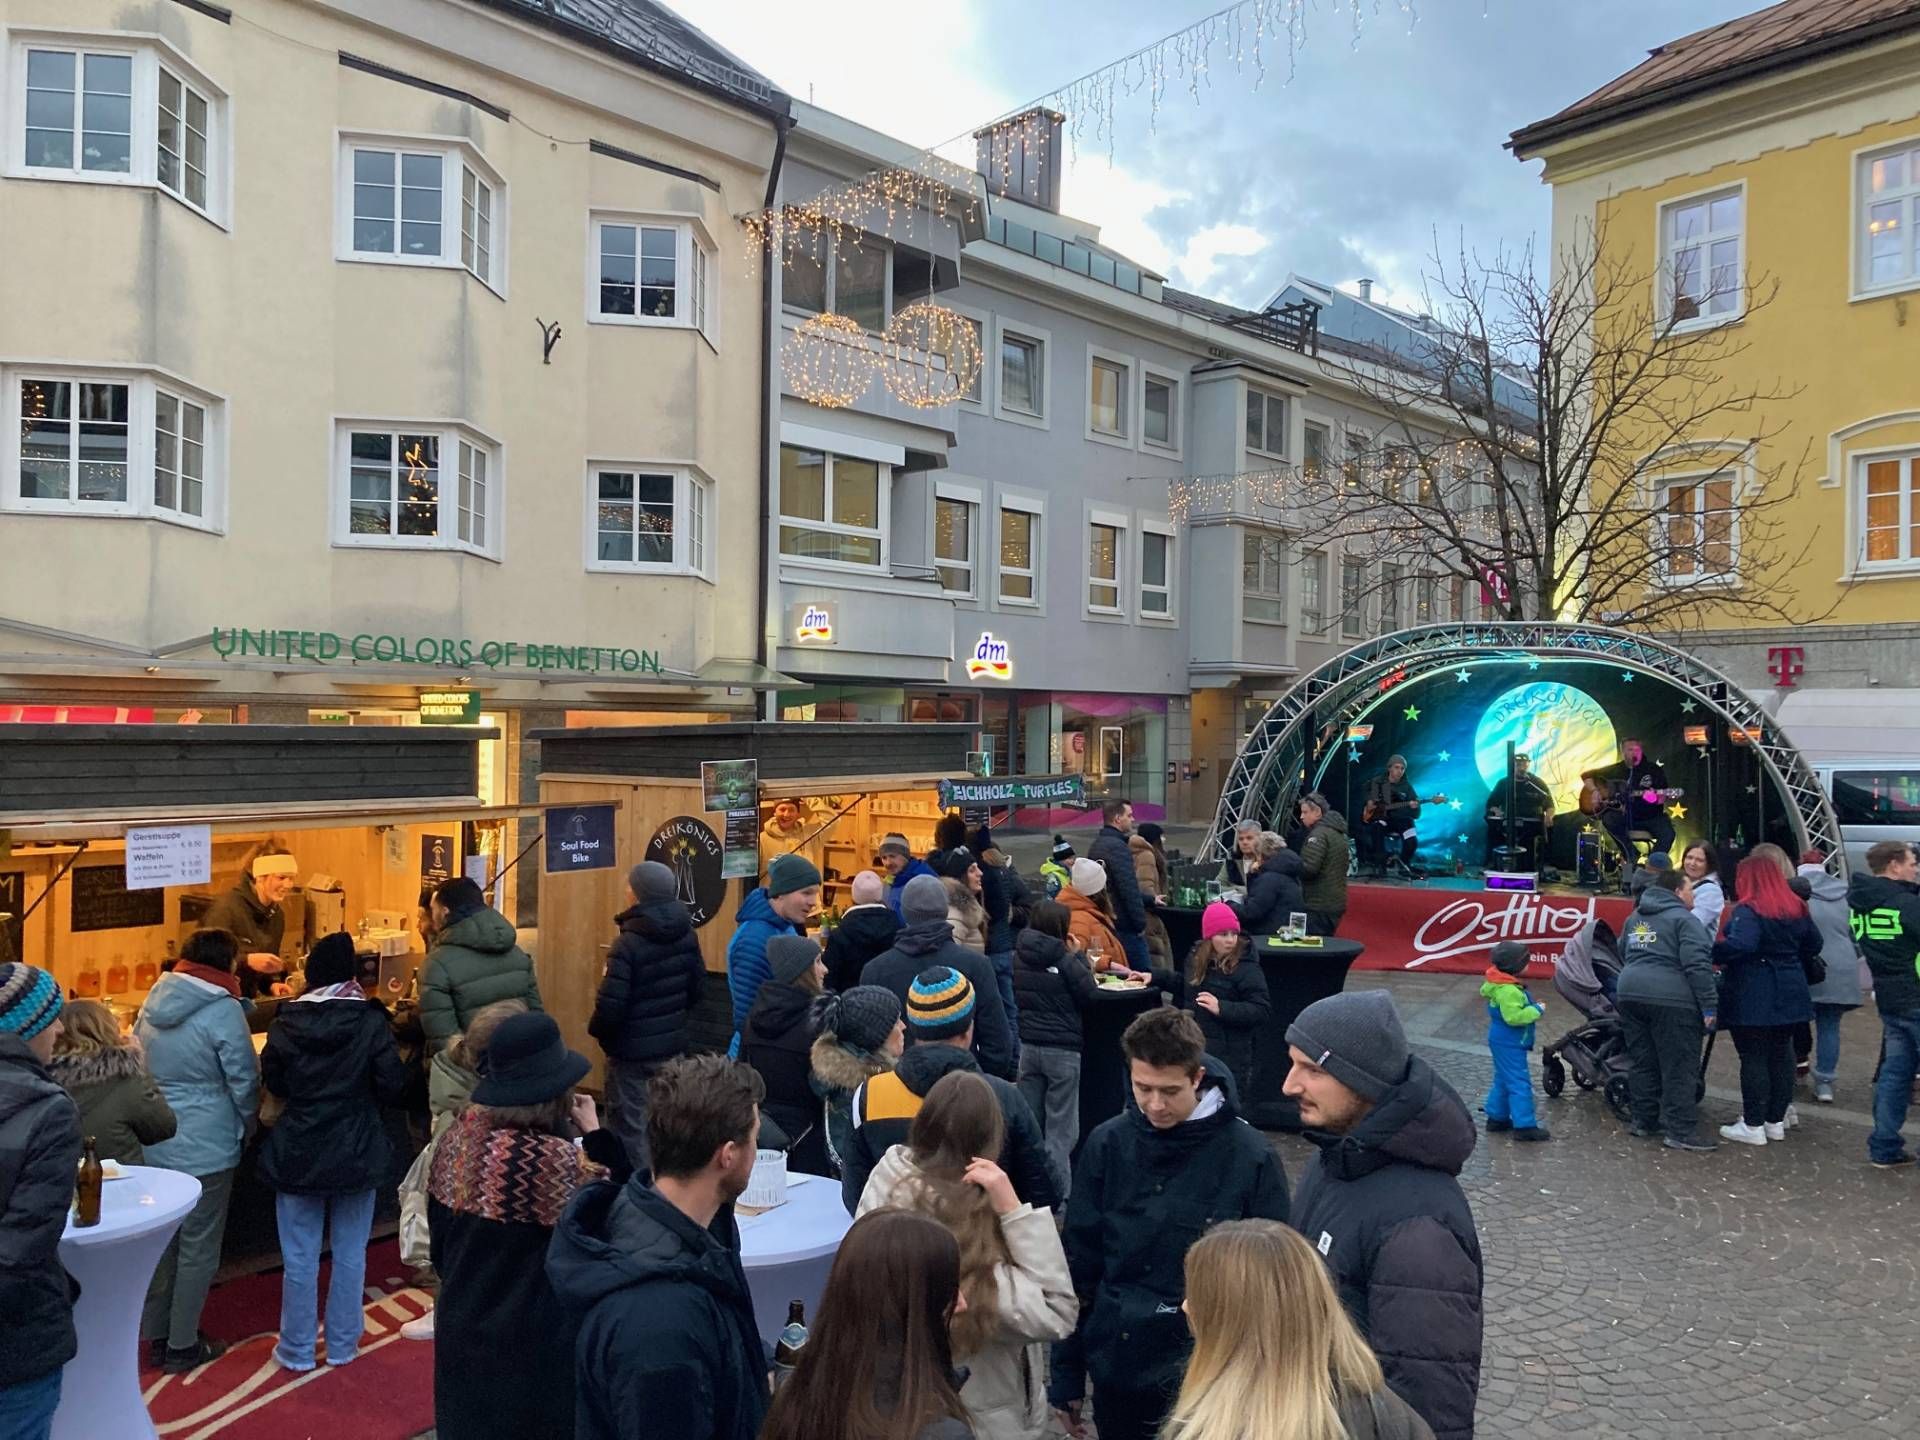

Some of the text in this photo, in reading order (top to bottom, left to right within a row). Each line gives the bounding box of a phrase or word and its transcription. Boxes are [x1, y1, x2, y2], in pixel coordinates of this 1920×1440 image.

[805, 609, 826, 627] dm
[212, 626, 341, 659] UNITED
[351, 633, 472, 666] COLORS
[480, 641, 518, 666] OF
[977, 636, 1005, 661] dm
[1768, 647, 1805, 686] T
[953, 780, 1073, 801] EICHHOLZ TURTLES
[561, 840, 600, 851] Soul Food
[654, 821, 719, 855] DREIKÖNIGS
[133, 852, 164, 862] Waffeln
[572, 853, 590, 863] Bike
